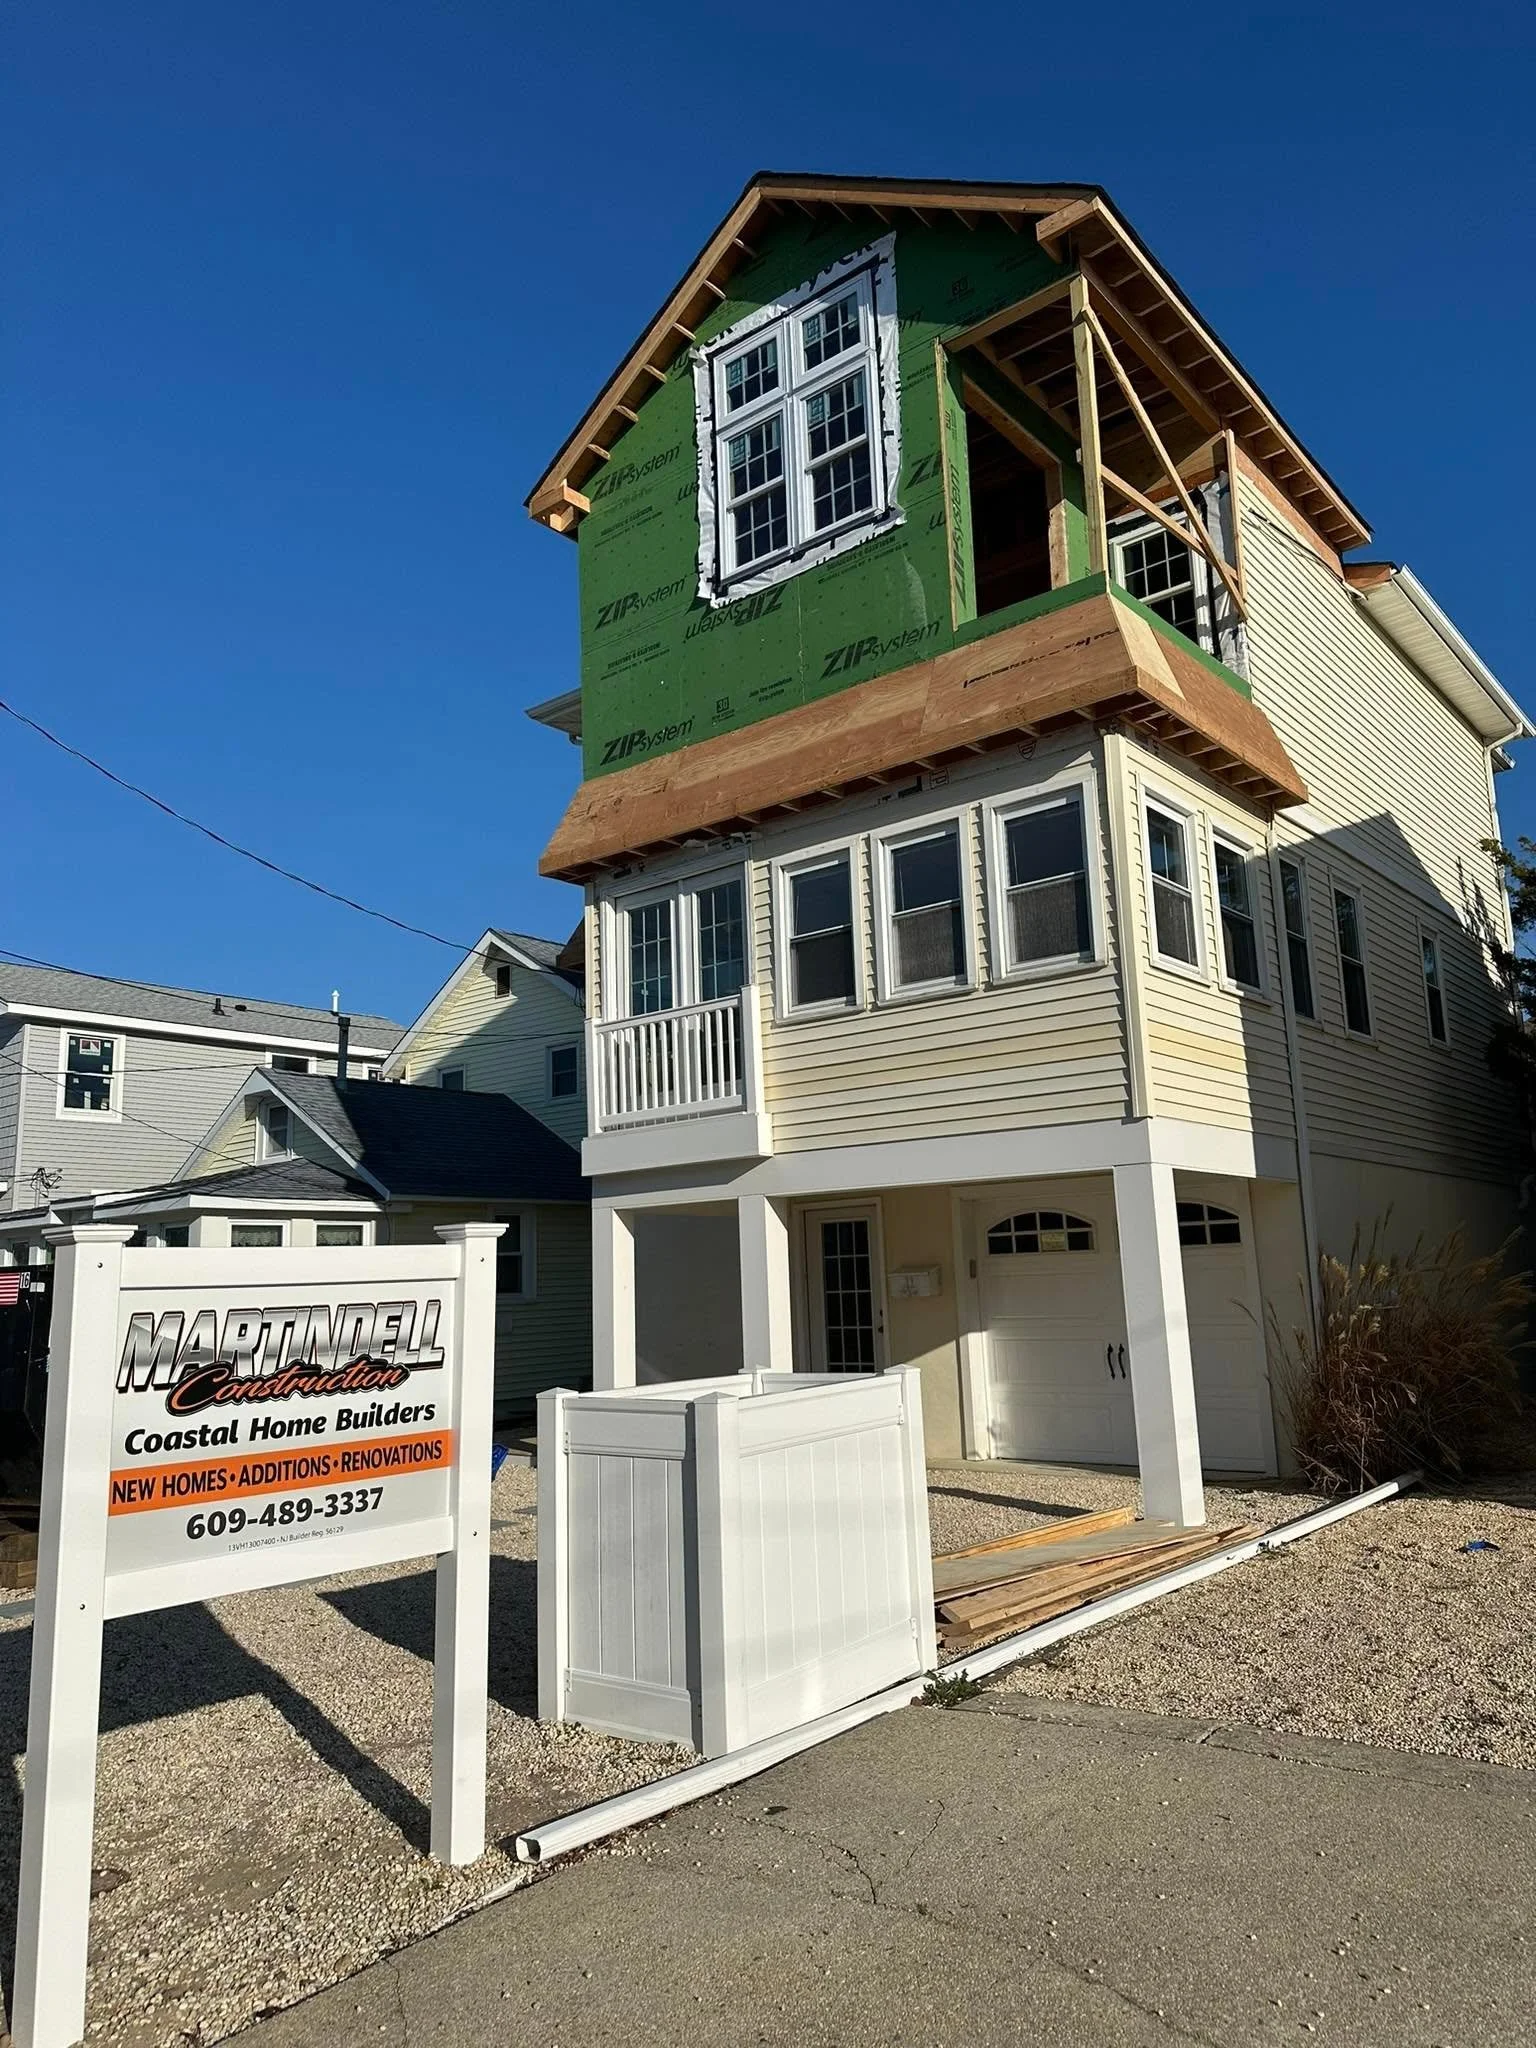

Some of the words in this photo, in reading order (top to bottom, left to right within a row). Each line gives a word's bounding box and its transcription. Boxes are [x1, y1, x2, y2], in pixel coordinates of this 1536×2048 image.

[21, 1272, 30, 1288] 16
[116, 1299, 445, 1393] MARTINDELL
[169, 1358, 405, 1412] Construction
[125, 1419, 239, 1455] Coastal
[249, 1416, 327, 1441] Home
[336, 1402, 436, 1431] Builders
[112, 1477, 157, 1505] NEW
[162, 1468, 227, 1497] HOMES
[238, 1455, 331, 1487] ADDITIONS
[341, 1440, 443, 1472] RENOVATIONS
[186, 1486, 384, 1540] 609-489-3337
